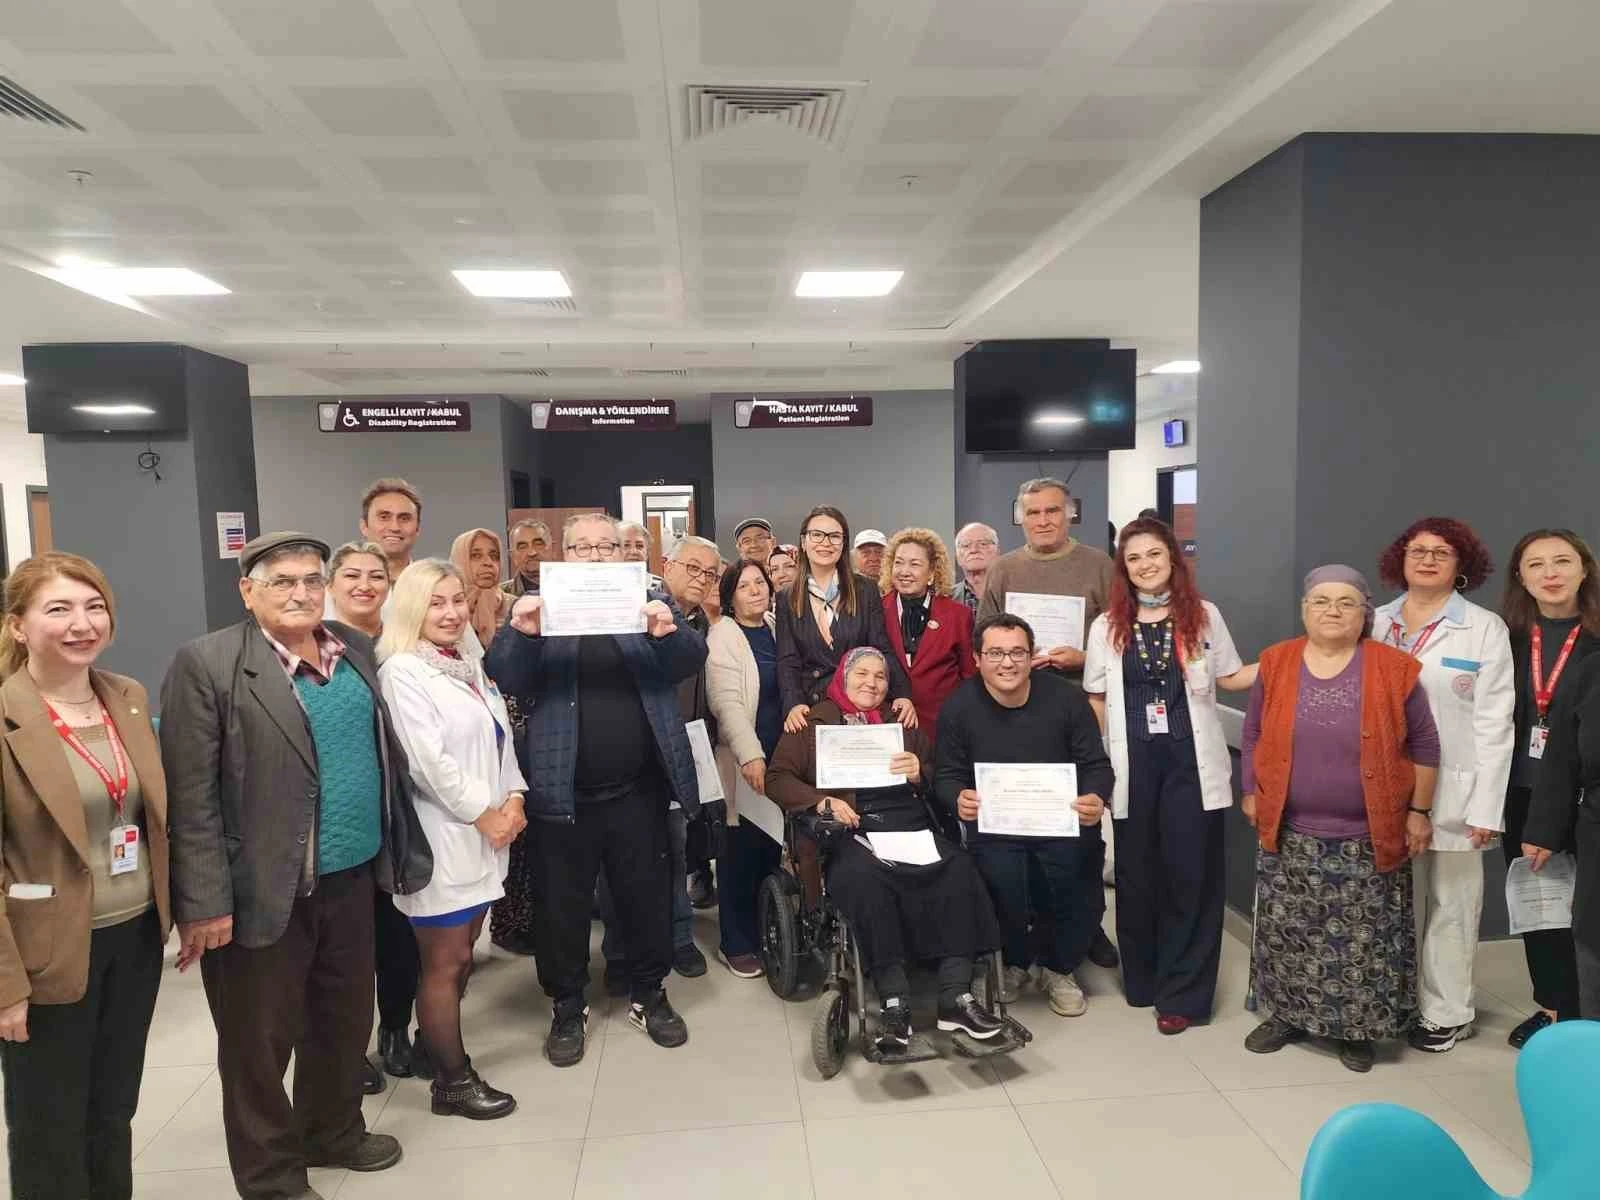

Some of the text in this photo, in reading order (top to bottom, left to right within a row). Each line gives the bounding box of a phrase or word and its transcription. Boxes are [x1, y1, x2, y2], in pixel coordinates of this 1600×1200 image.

[362, 407, 399, 417] ENGELLİ
[400, 408, 425, 417] KAYIT
[431, 408, 462, 417] KABUL
[555, 405, 670, 417] DANIŞMA & YÖNLENDİRME
[799, 404, 824, 413] KAYIT
[829, 404, 859, 413] KABUL
[368, 419, 457, 428] Disability Registration
[805, 415, 850, 423] Registration
